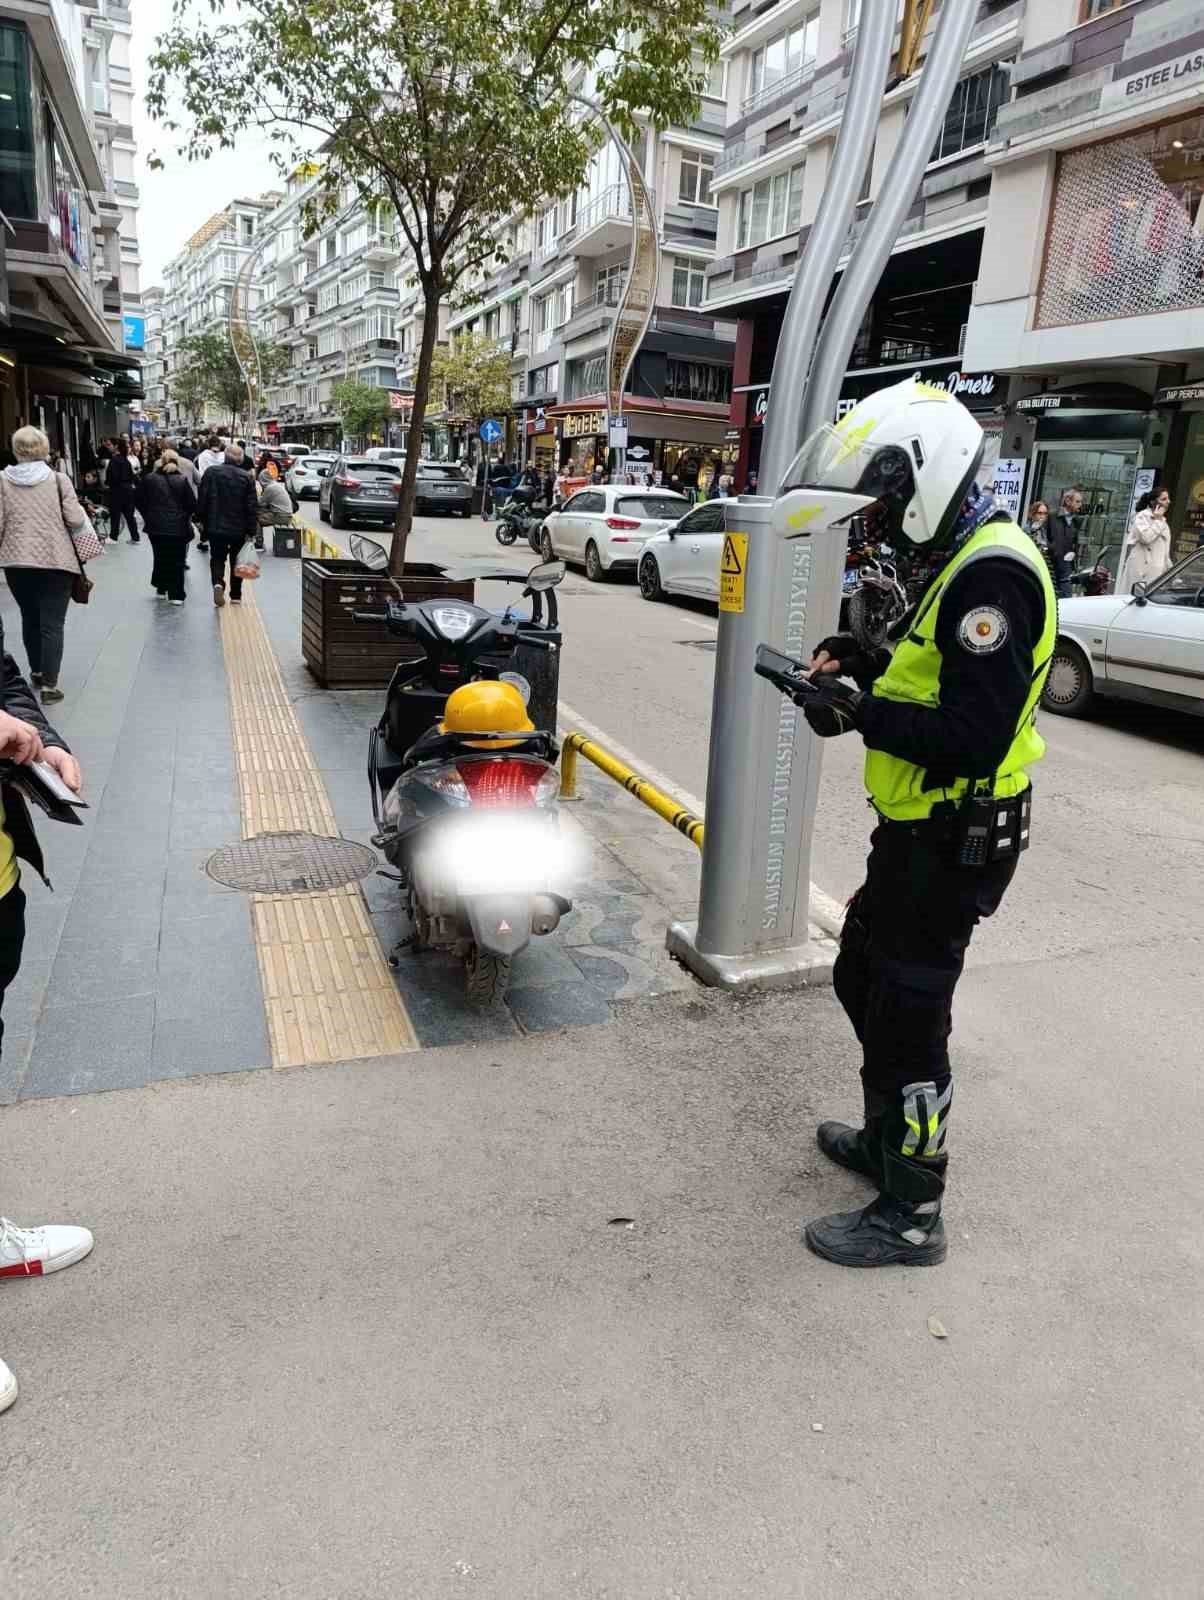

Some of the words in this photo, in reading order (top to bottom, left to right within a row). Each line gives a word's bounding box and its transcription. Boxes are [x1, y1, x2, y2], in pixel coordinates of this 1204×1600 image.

[1126, 66, 1171, 95] ESTEE
[1173, 55, 1204, 78] LAS
[992, 480, 1019, 496] PETRA
[762, 841, 786, 929] SAMSUN
[784, 543, 812, 663] LEDİYESİ
